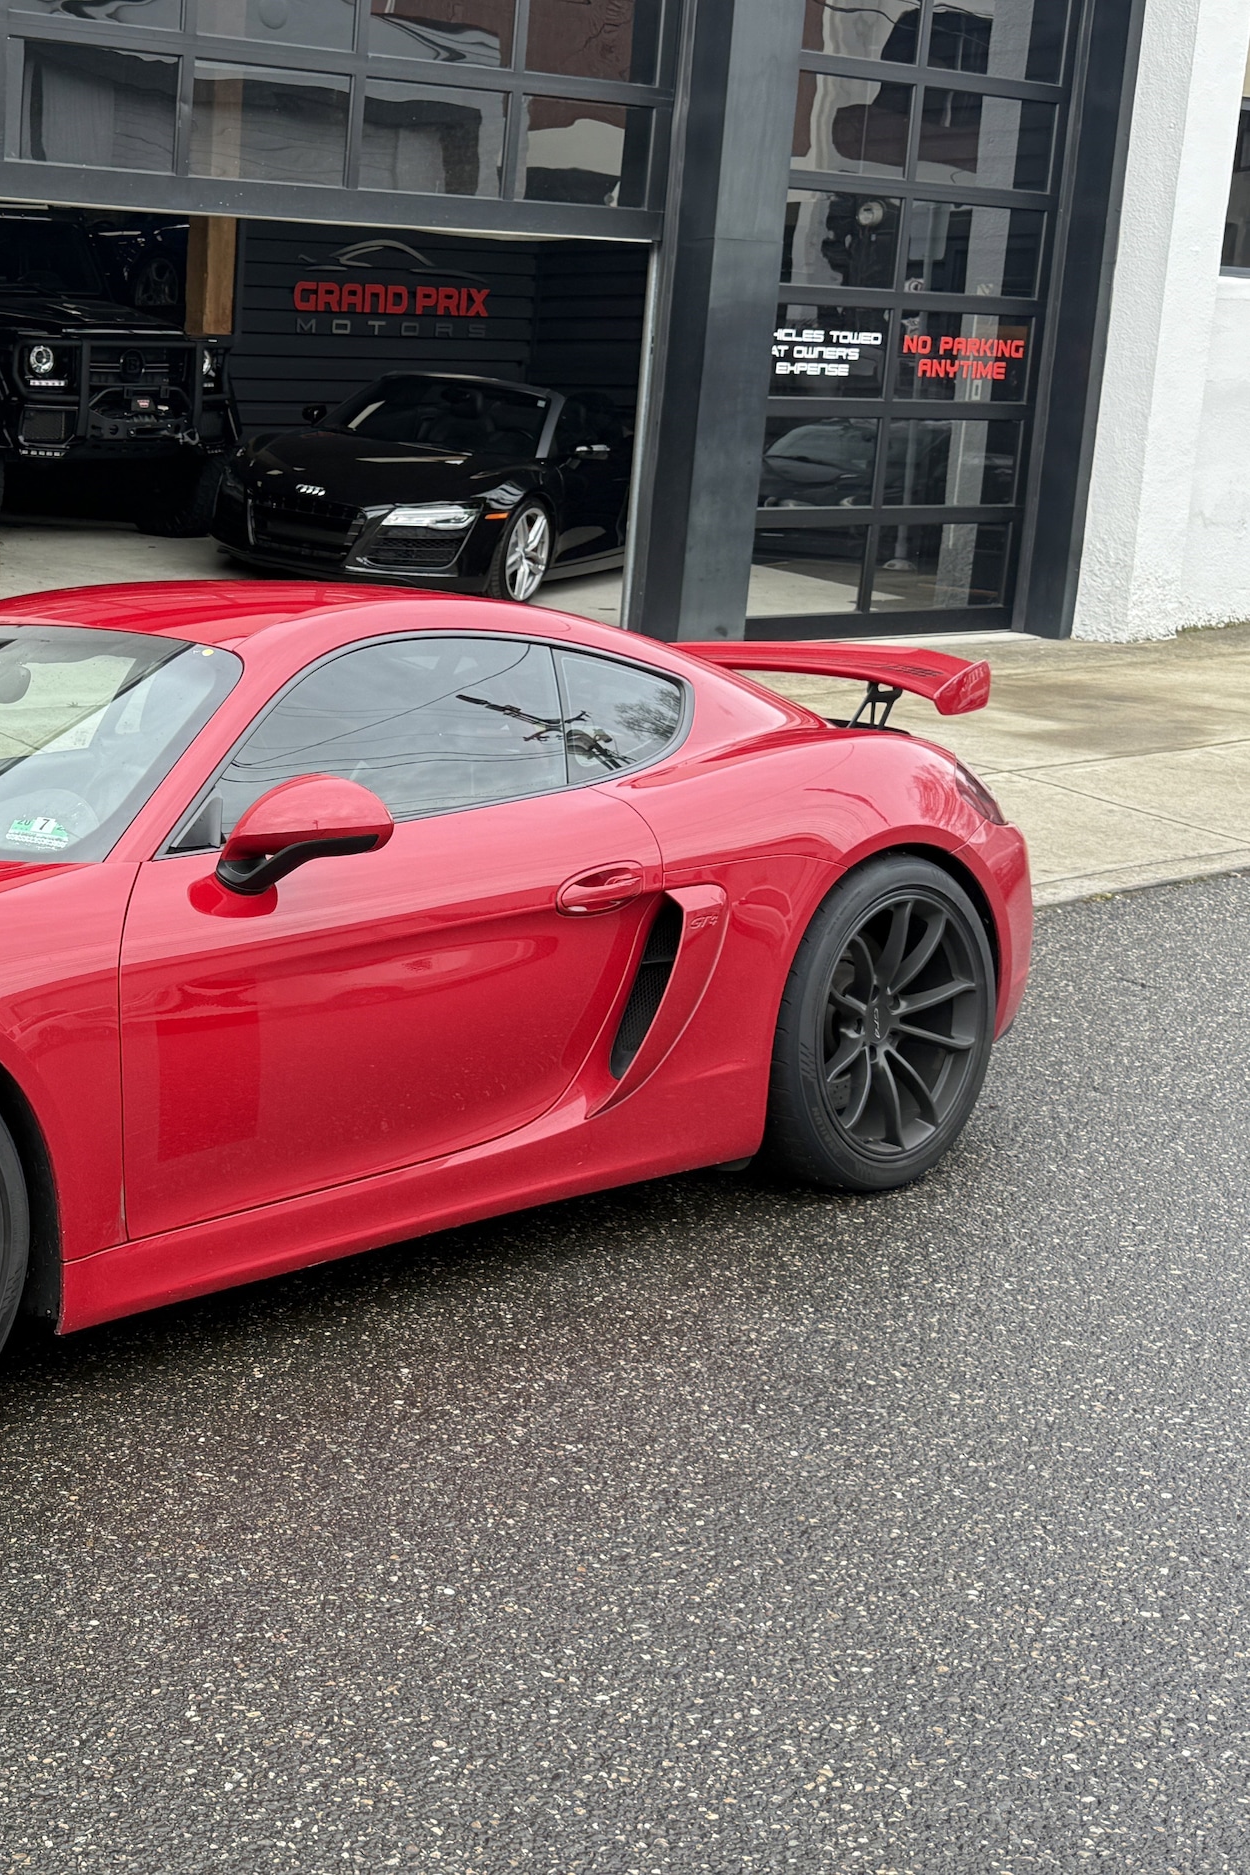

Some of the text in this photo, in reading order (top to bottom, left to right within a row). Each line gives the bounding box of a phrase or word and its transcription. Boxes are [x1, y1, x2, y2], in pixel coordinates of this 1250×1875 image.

[293, 281, 491, 317] GRAND PRIX
[296, 318, 487, 338] MOTORS
[773, 328, 883, 345] HICLES TOWED
[771, 344, 789, 358] AT
[902, 334, 1025, 359] NO PARKING
[775, 361, 850, 377] EXPENSE
[917, 358, 1007, 380] ANYTIME
[39, 818, 50, 831] 7
[690, 914, 719, 930] GT4
[873, 1007, 881, 1039] GT4
